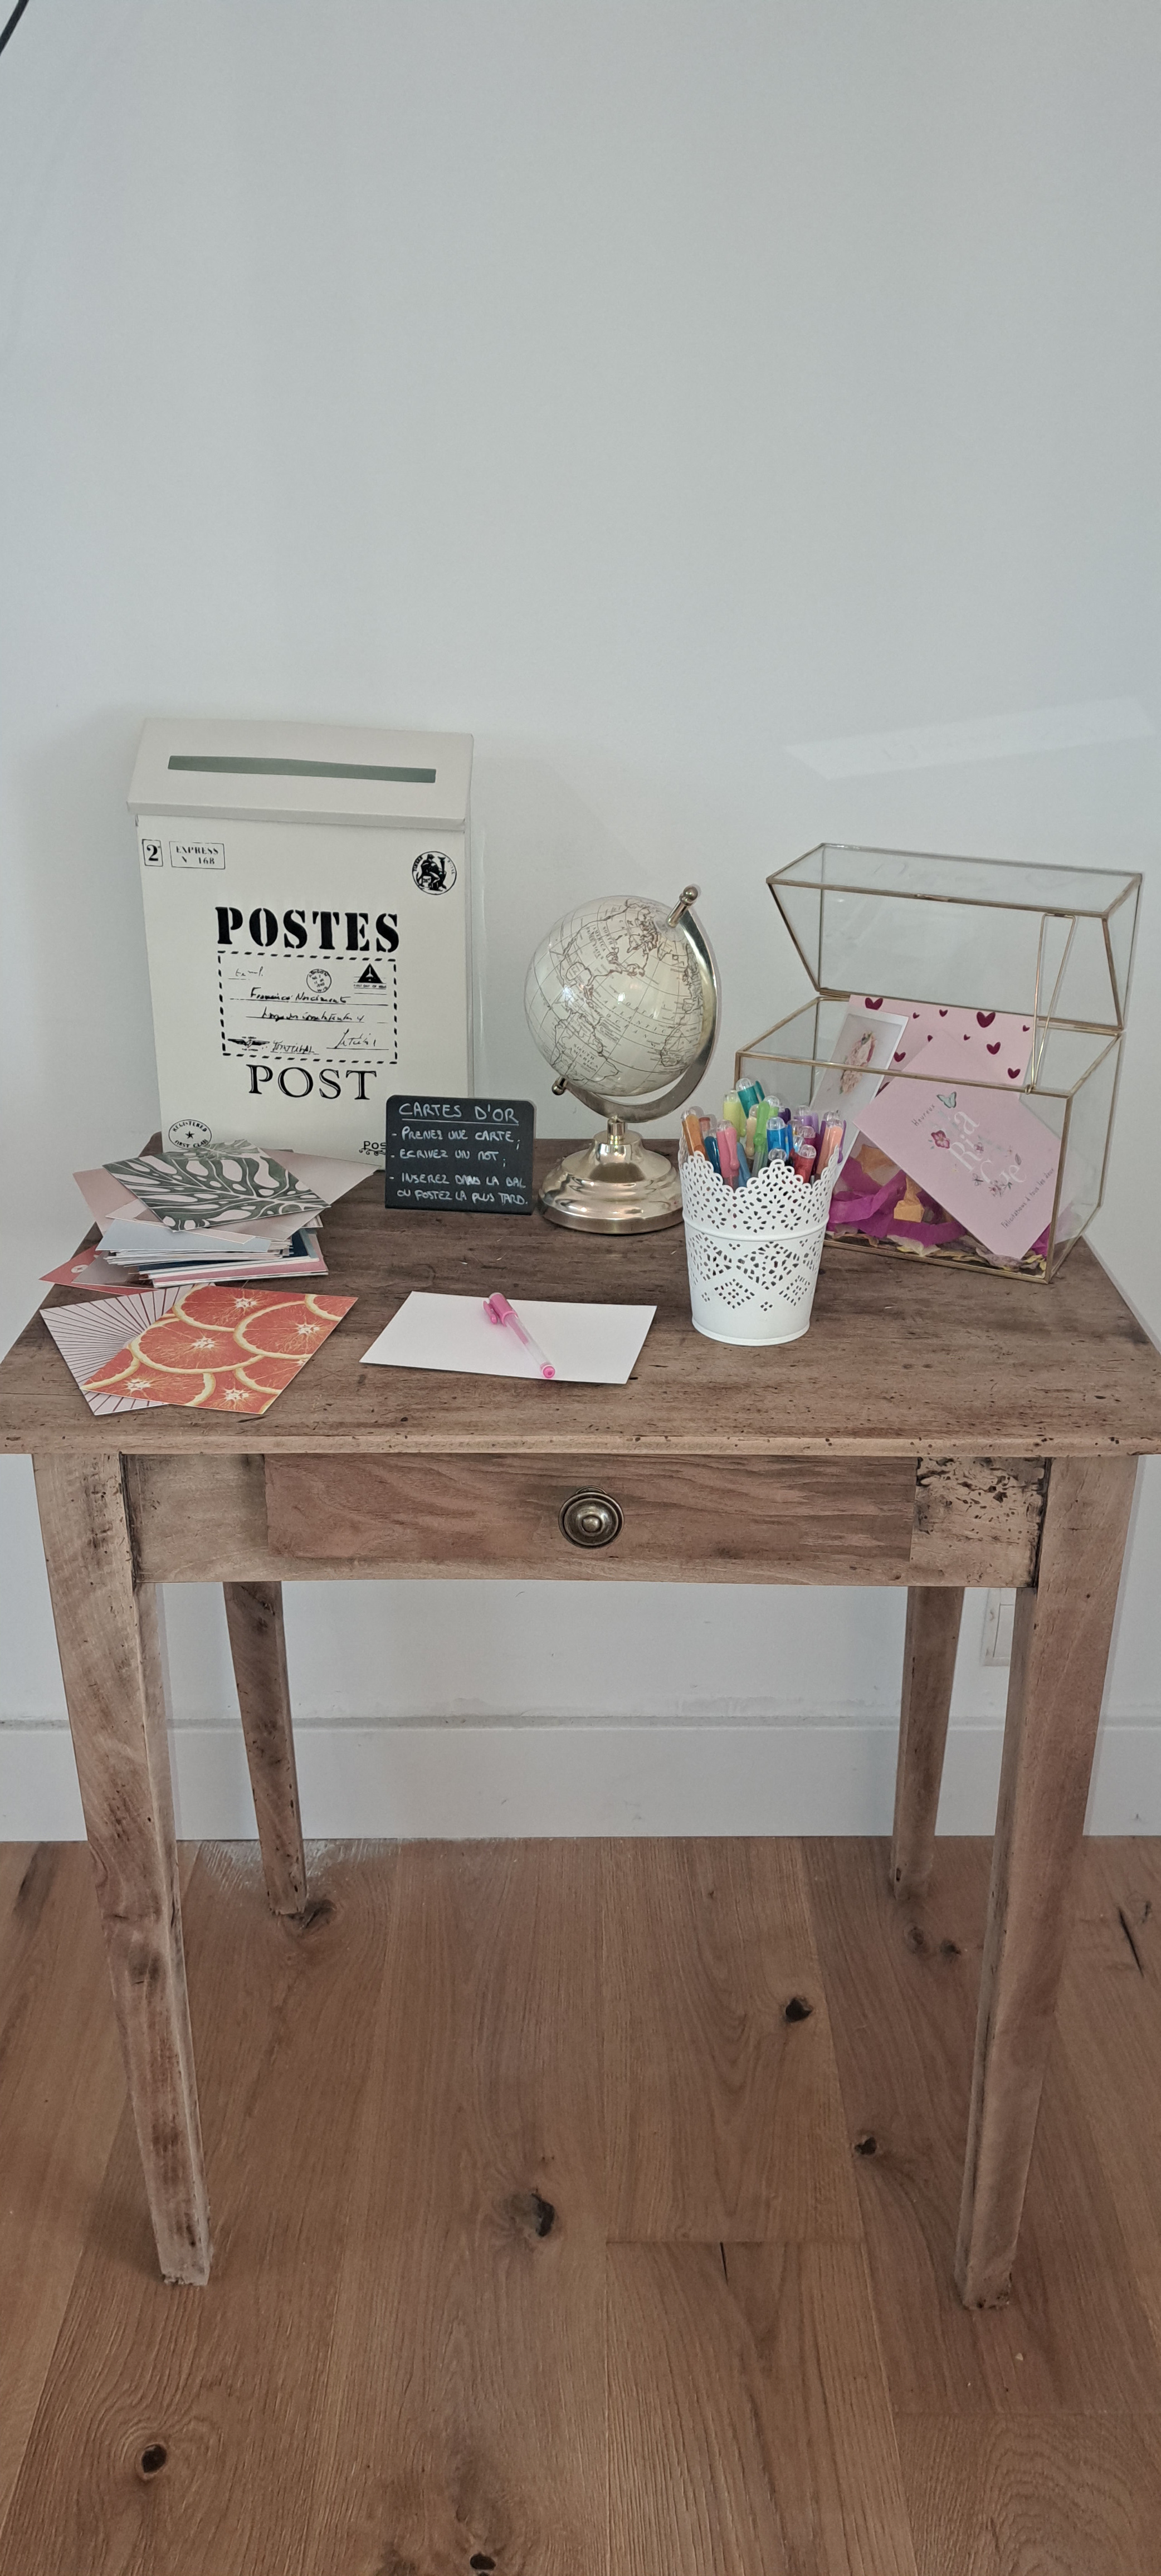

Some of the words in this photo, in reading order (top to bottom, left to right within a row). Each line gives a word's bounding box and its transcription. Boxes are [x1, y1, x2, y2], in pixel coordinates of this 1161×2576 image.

[176, 846, 219, 855] EXPRESS
[215, 906, 399, 953] POSTES
[246, 1064, 377, 1100] POST
[399, 1102, 462, 1118] CARTES
[475, 1104, 519, 1124] D'OR
[911, 1104, 935, 1126] Heureux
[402, 1126, 443, 1140] PRENEZ
[448, 1130, 469, 1140] UNE
[400, 1149, 448, 1159] ECRIVEZ
[455, 1150, 470, 1159] UN
[402, 1172, 450, 1184] INSEREZ
[486, 1175, 499, 1185] LA
[397, 1188, 411, 1197] OU
[414, 1189, 453, 1201] POSTEZ
[455, 1190, 467, 1201] LA
[471, 1192, 495, 1203] PLUS
[498, 1192, 528, 1206] TARD.
